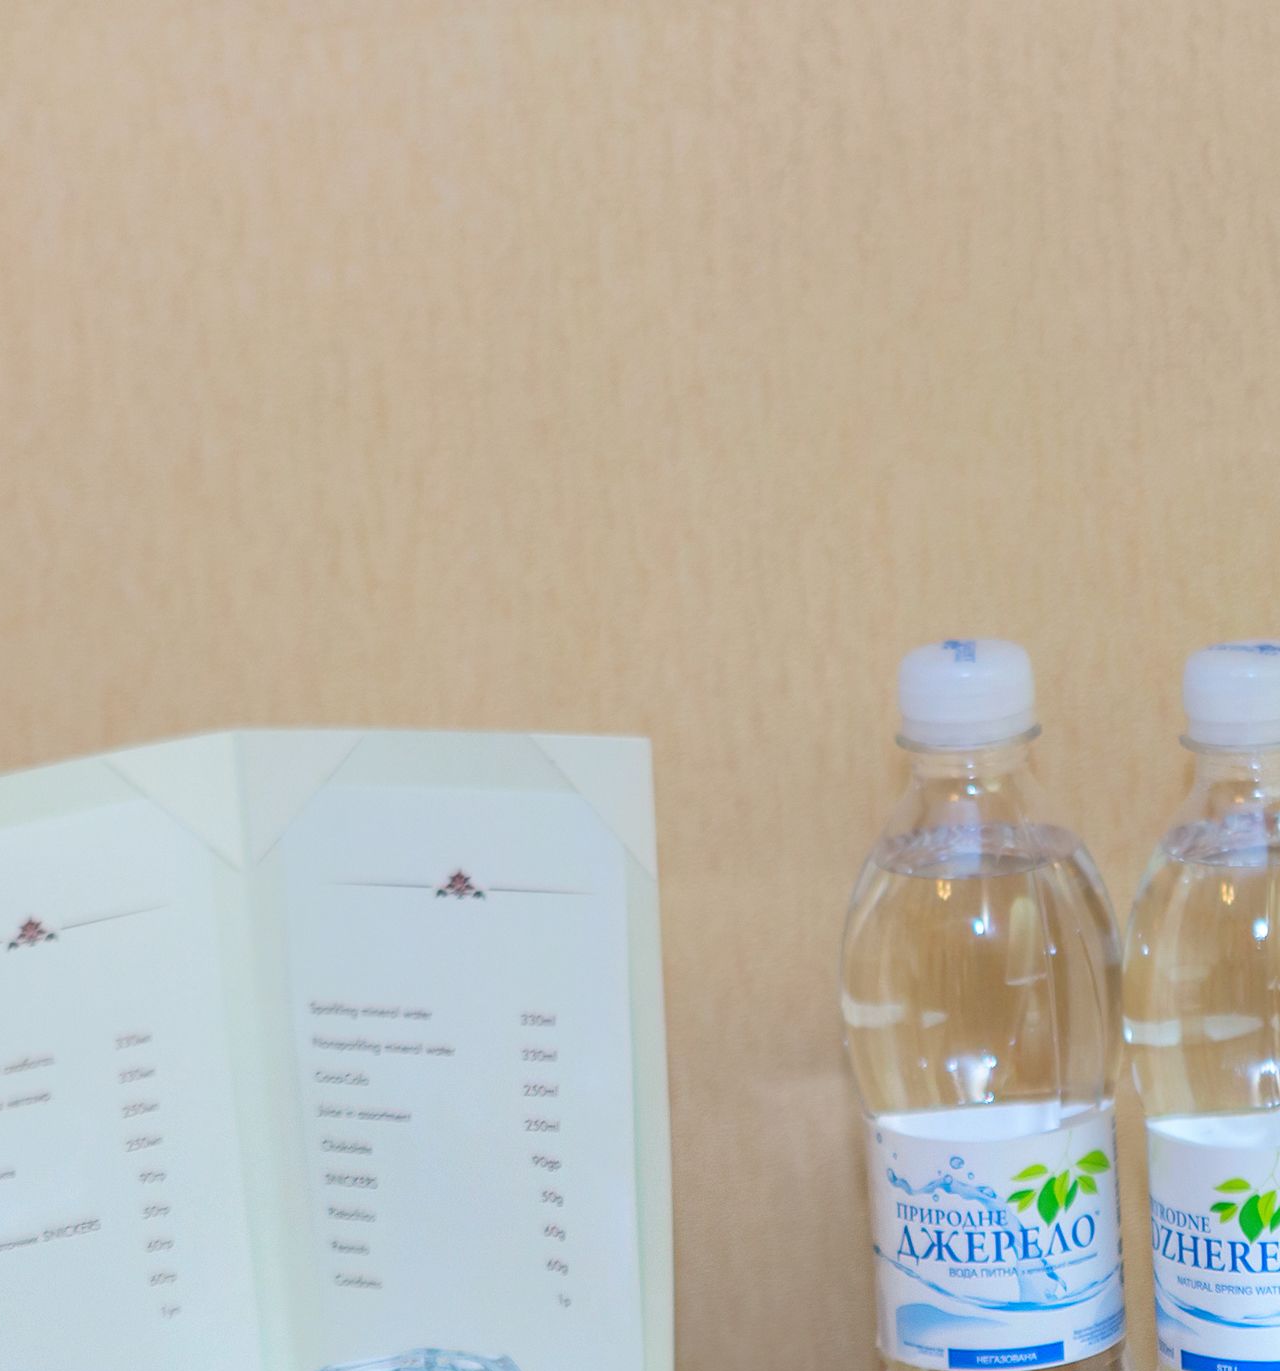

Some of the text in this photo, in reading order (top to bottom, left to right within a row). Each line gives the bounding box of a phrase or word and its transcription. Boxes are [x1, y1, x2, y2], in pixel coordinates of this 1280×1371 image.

[520, 1014, 556, 1026] 330ml
[521, 1049, 557, 1061] 330ml
[523, 1084, 559, 1097] 250ml
[524, 1120, 560, 1132] 250ml
[542, 1190, 564, 1207] 50g
[897, 1203, 1009, 1231] ПРИРОДНЕ
[897, 1214, 1096, 1265] ДЖЕРЕЛО
[949, 1267, 1017, 1279] ВОДА ПИТНА
[1177, 1276, 1213, 1294] NATURAL
[1215, 1283, 1253, 1296] SPRING
